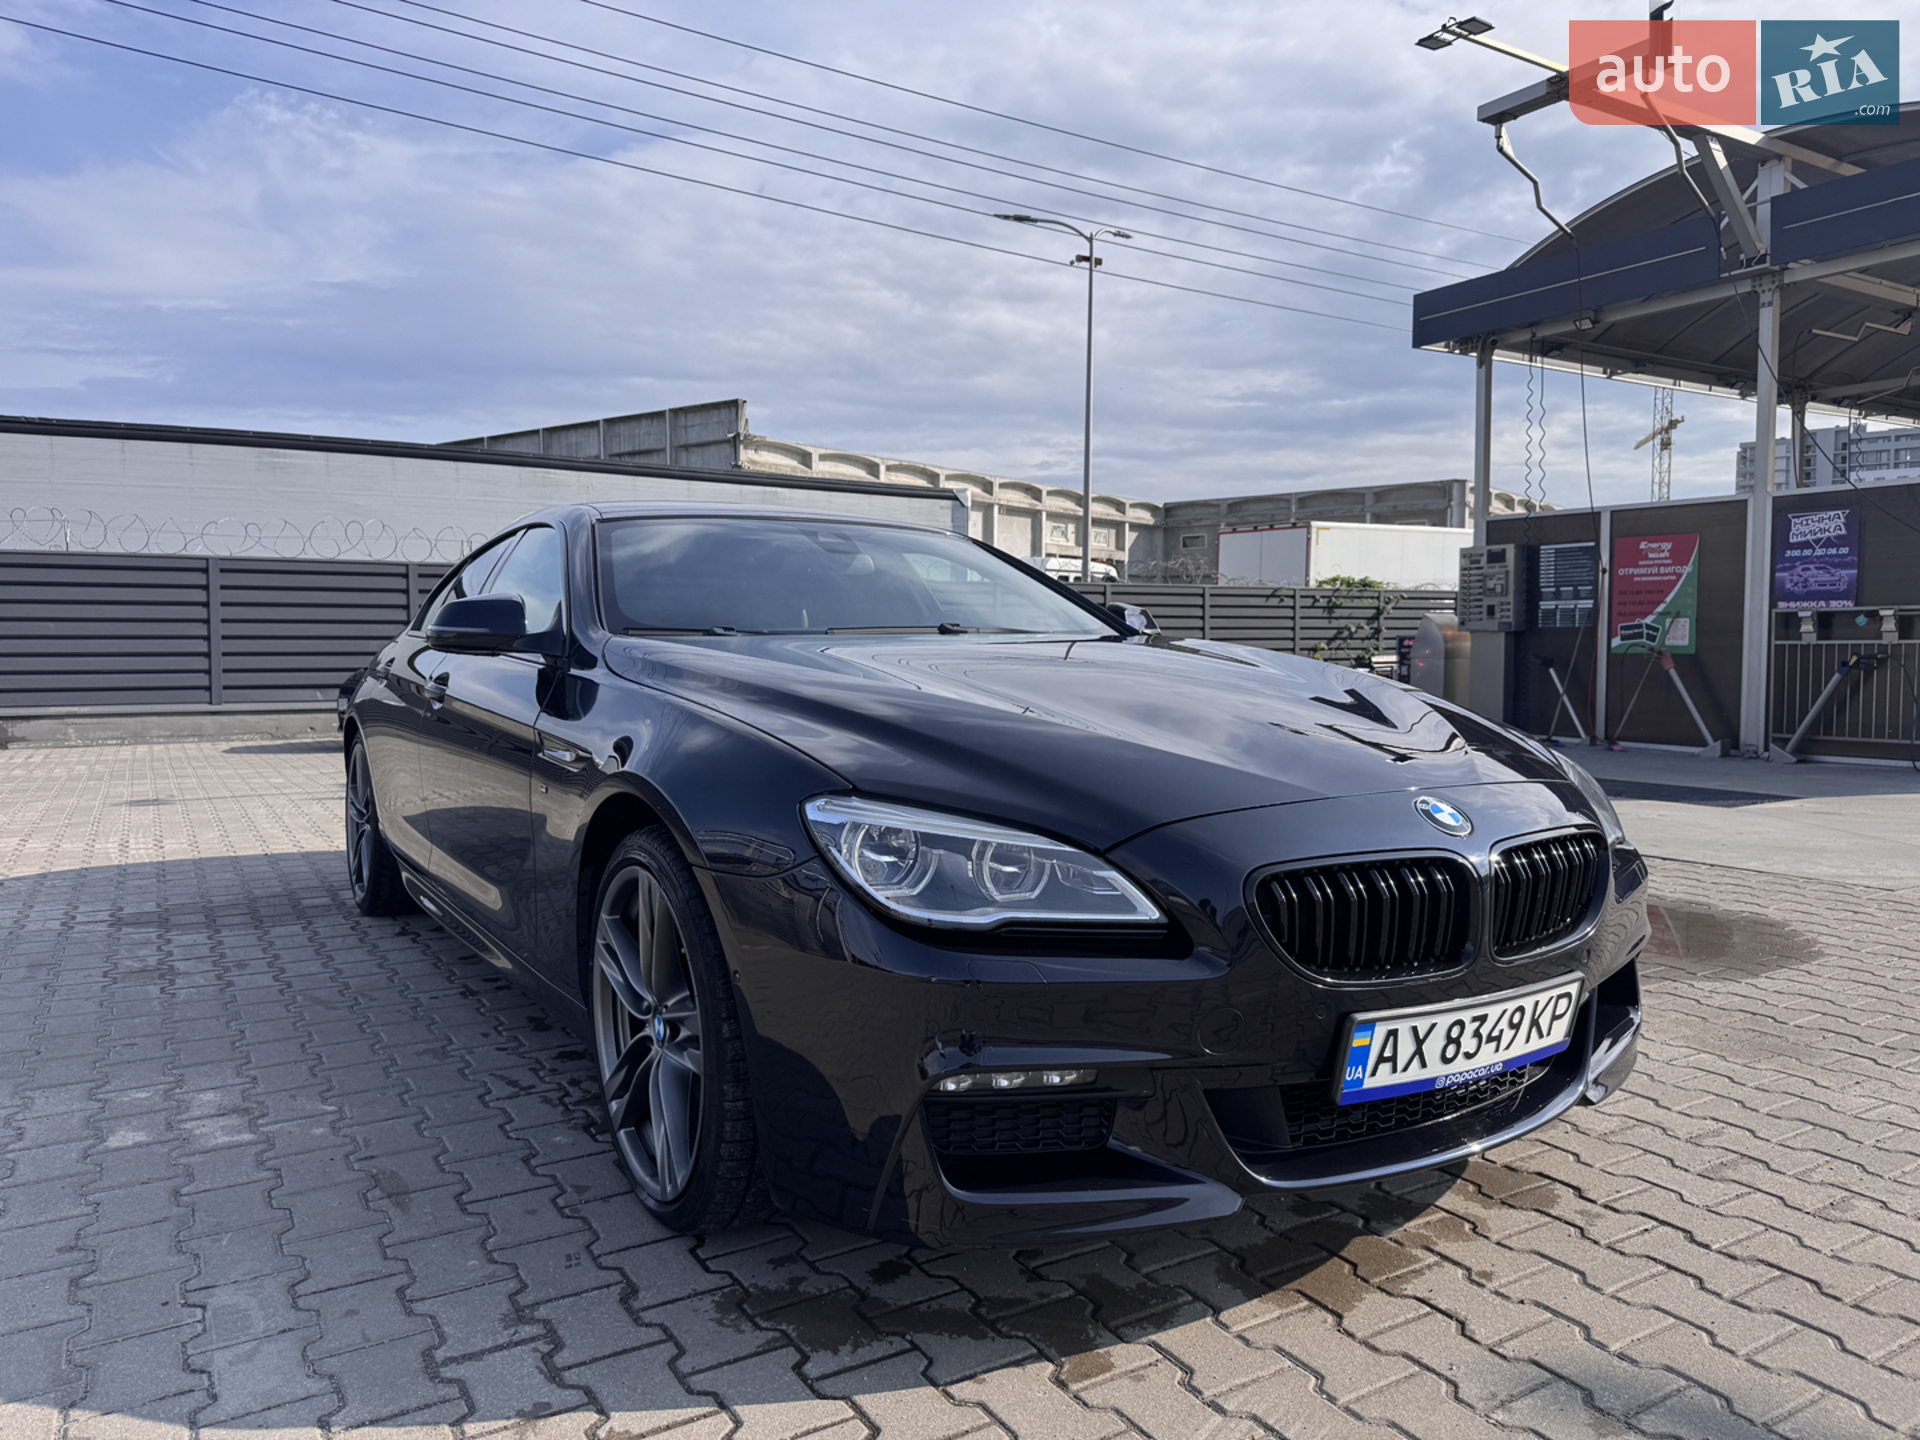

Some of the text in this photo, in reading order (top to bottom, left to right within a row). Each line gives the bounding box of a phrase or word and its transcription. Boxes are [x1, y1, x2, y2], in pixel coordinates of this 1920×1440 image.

[1792, 512, 1844, 530] НІЧНА
[1790, 523, 1845, 541] МИЙКА
[1618, 564, 1694, 576] ОТРИМУЙ ВИГОДУ
[1777, 600, 1827, 609] ЗНИЖКА
[1369, 1022, 1438, 1078] AX
[1441, 1005, 1526, 1065] 8349
[1345, 1065, 1363, 1081] UA
